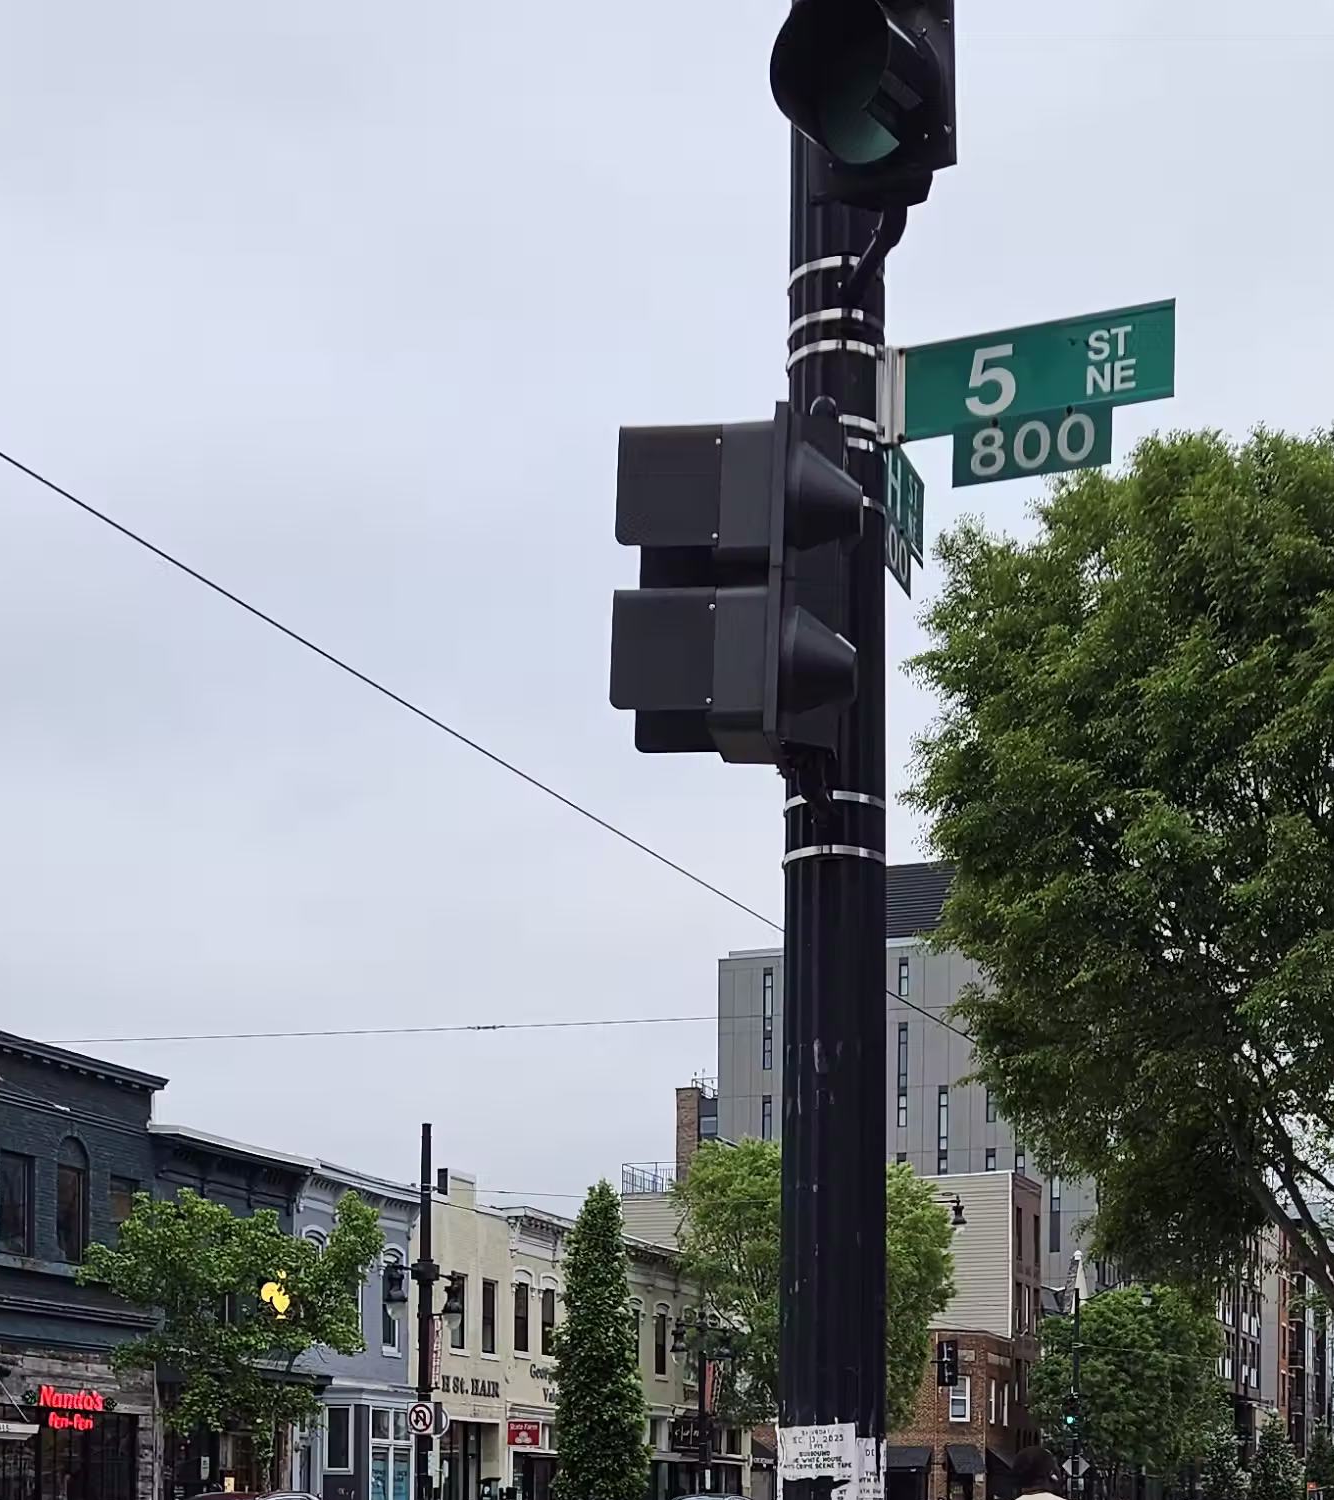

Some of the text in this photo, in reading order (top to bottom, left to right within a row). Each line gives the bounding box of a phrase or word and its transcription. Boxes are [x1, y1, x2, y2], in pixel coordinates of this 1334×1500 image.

[1087, 325, 1133, 361] ST
[965, 343, 1016, 417] 5
[1086, 358, 1137, 395] NE
[970, 414, 1095, 477] 800
[887, 449, 901, 522] H
[885, 524, 908, 583] 00
[39, 1385, 104, 1411] Nando's
[442, 1375, 451, 1394] H
[471, 1378, 500, 1399] HAIR
